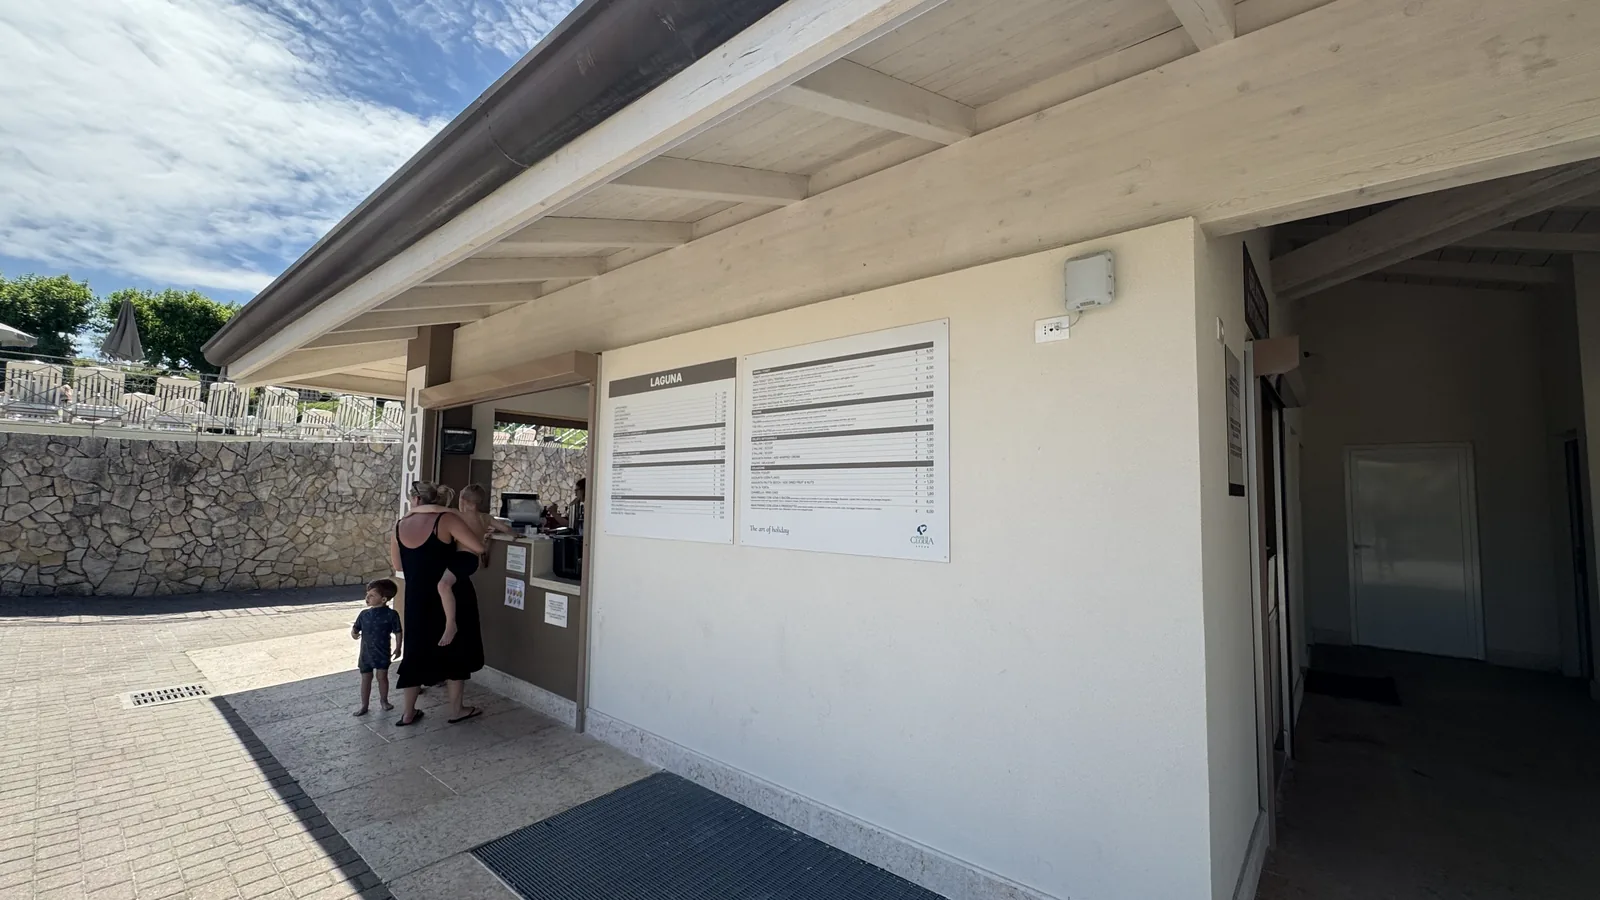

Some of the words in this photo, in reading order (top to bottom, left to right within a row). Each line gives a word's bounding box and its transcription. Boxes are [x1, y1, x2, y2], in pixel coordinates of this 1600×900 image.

[650, 372, 682, 387] LAGUNA
[766, 526, 771, 534] of
[771, 526, 790, 535] holiday
